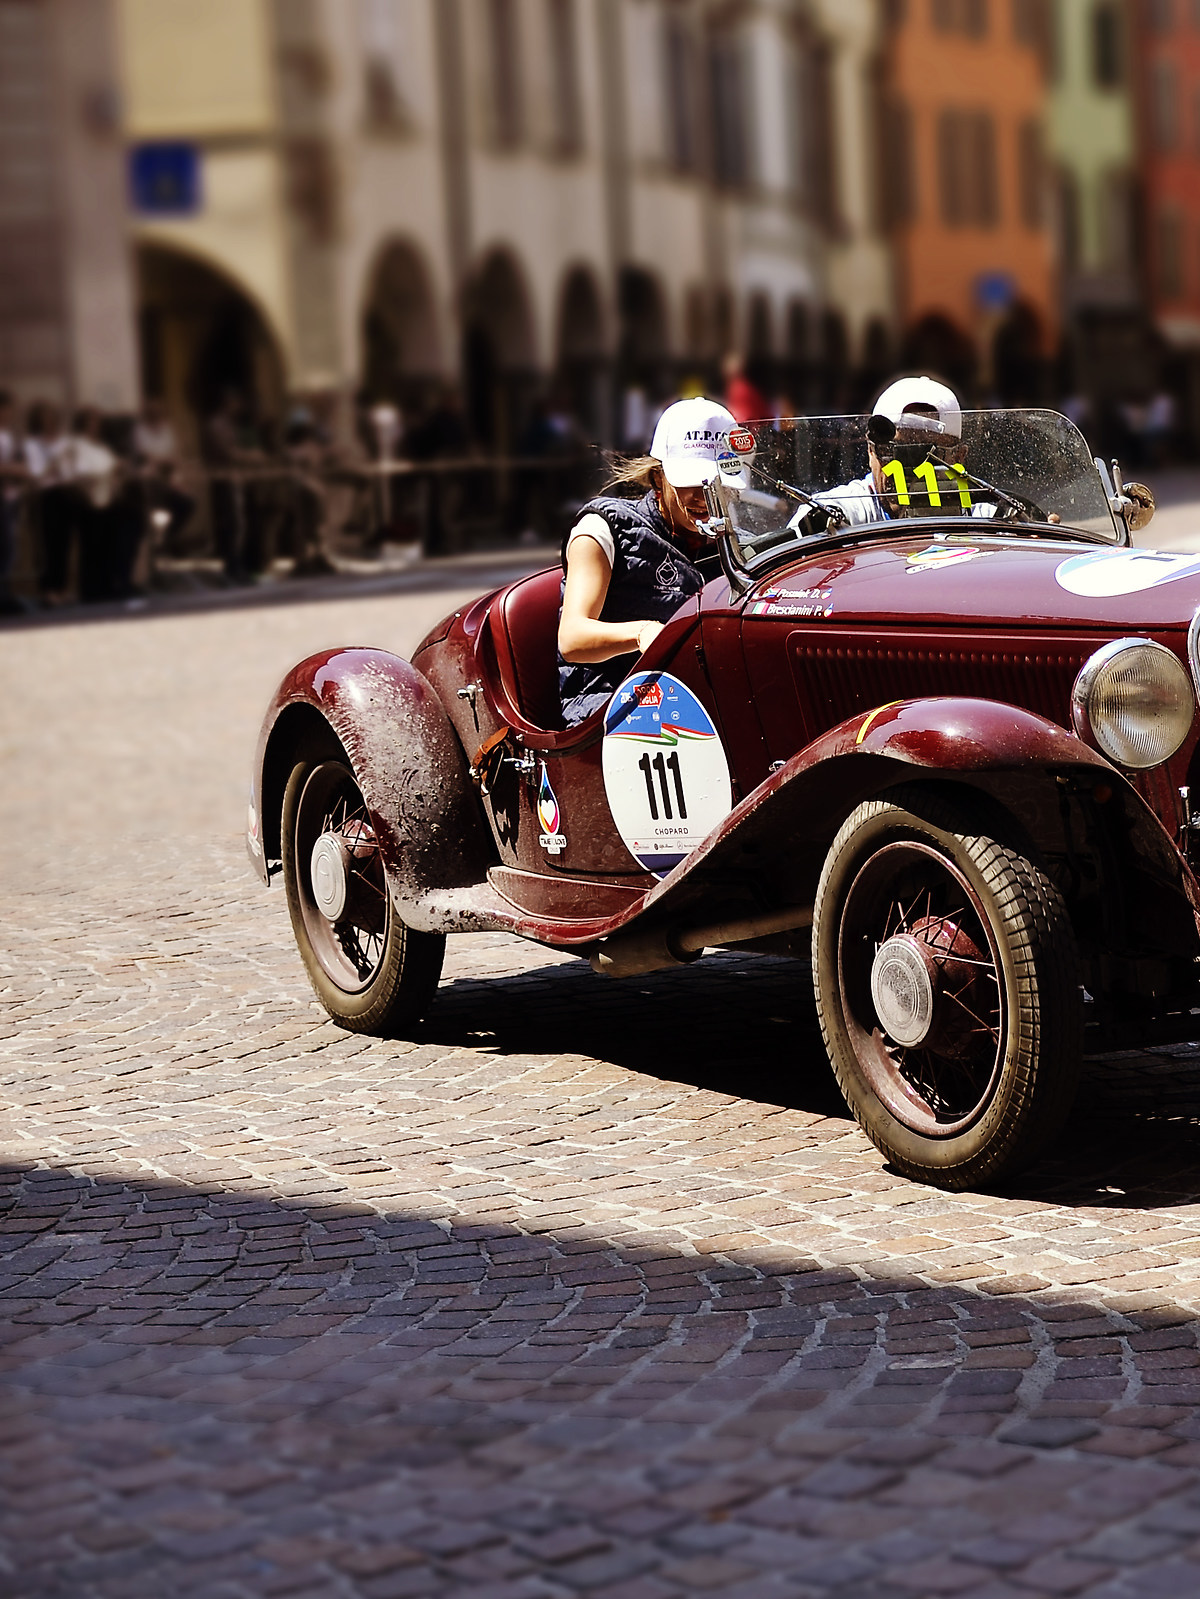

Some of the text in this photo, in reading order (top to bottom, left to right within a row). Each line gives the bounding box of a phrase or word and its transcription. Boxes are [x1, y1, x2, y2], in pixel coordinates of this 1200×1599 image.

[733, 436, 750, 446] 2015
[881, 459, 972, 508] 111
[638, 752, 688, 820] 111
